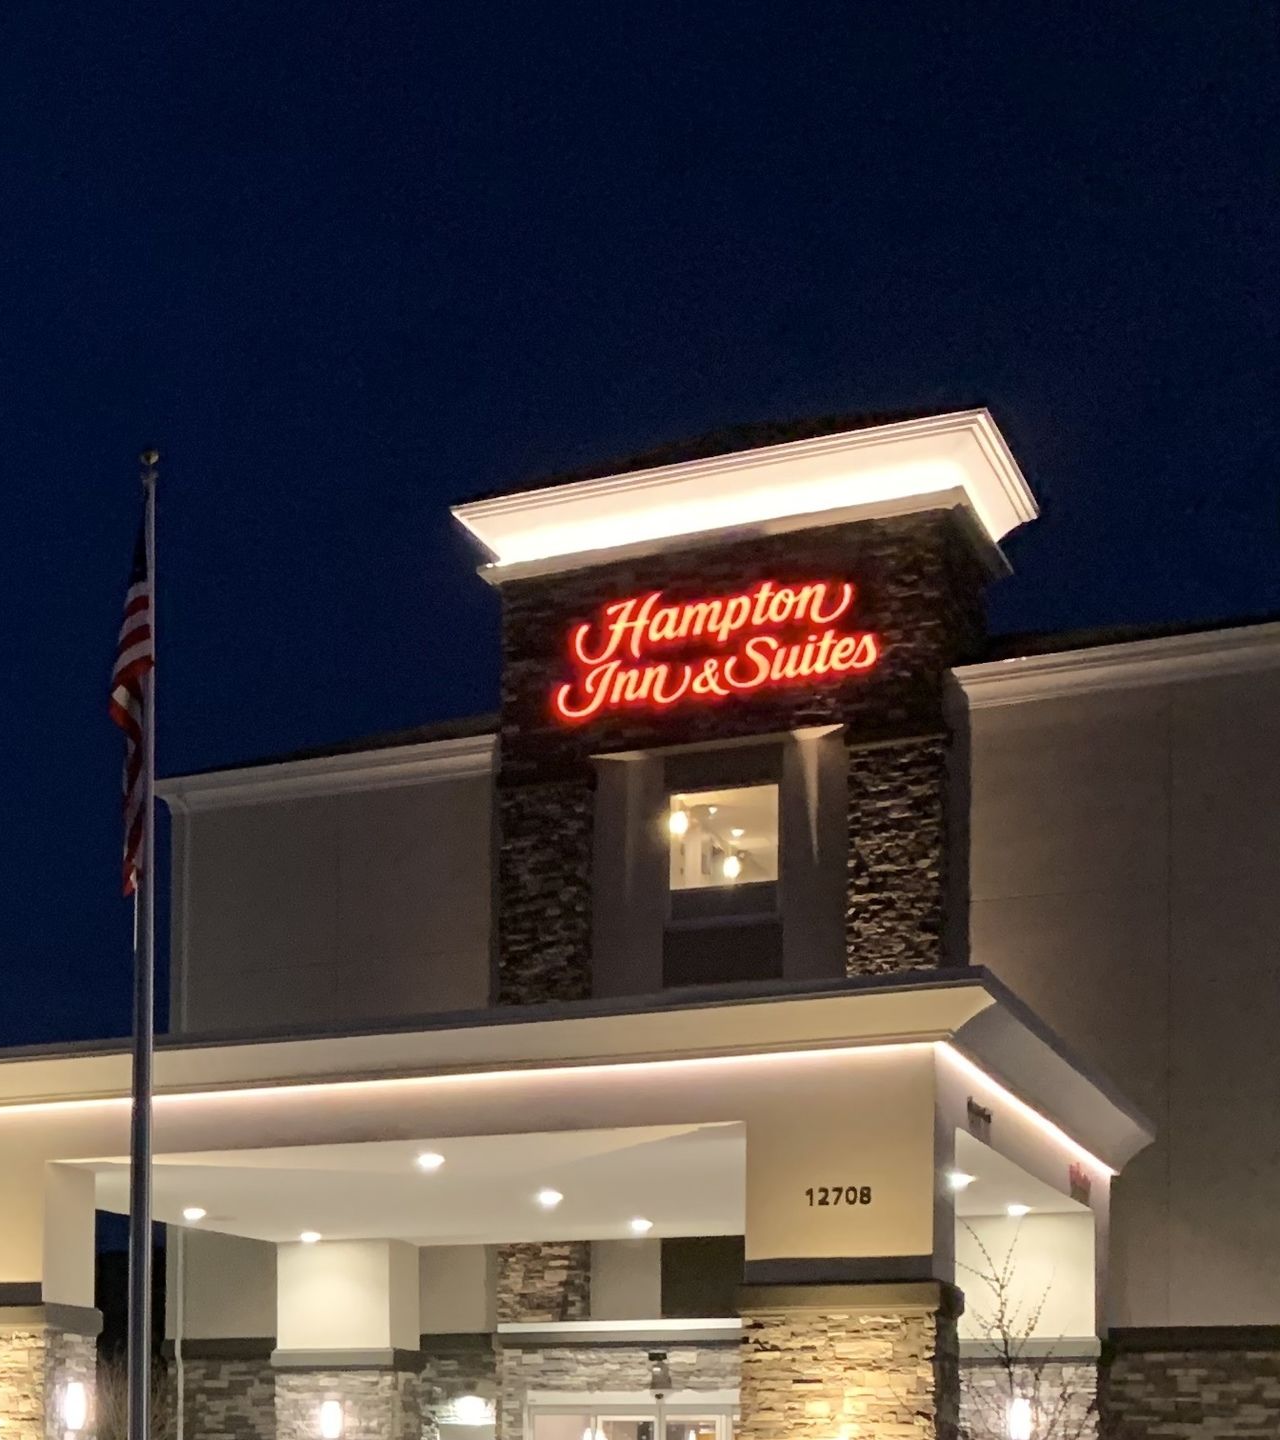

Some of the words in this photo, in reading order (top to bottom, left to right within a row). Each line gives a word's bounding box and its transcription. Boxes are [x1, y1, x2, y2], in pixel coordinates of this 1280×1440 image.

[575, 581, 852, 665] Hampton
[557, 659, 692, 718] Inn
[692, 658, 730, 695] &
[724, 629, 878, 688] Suites
[805, 1186, 871, 1206] 12708
